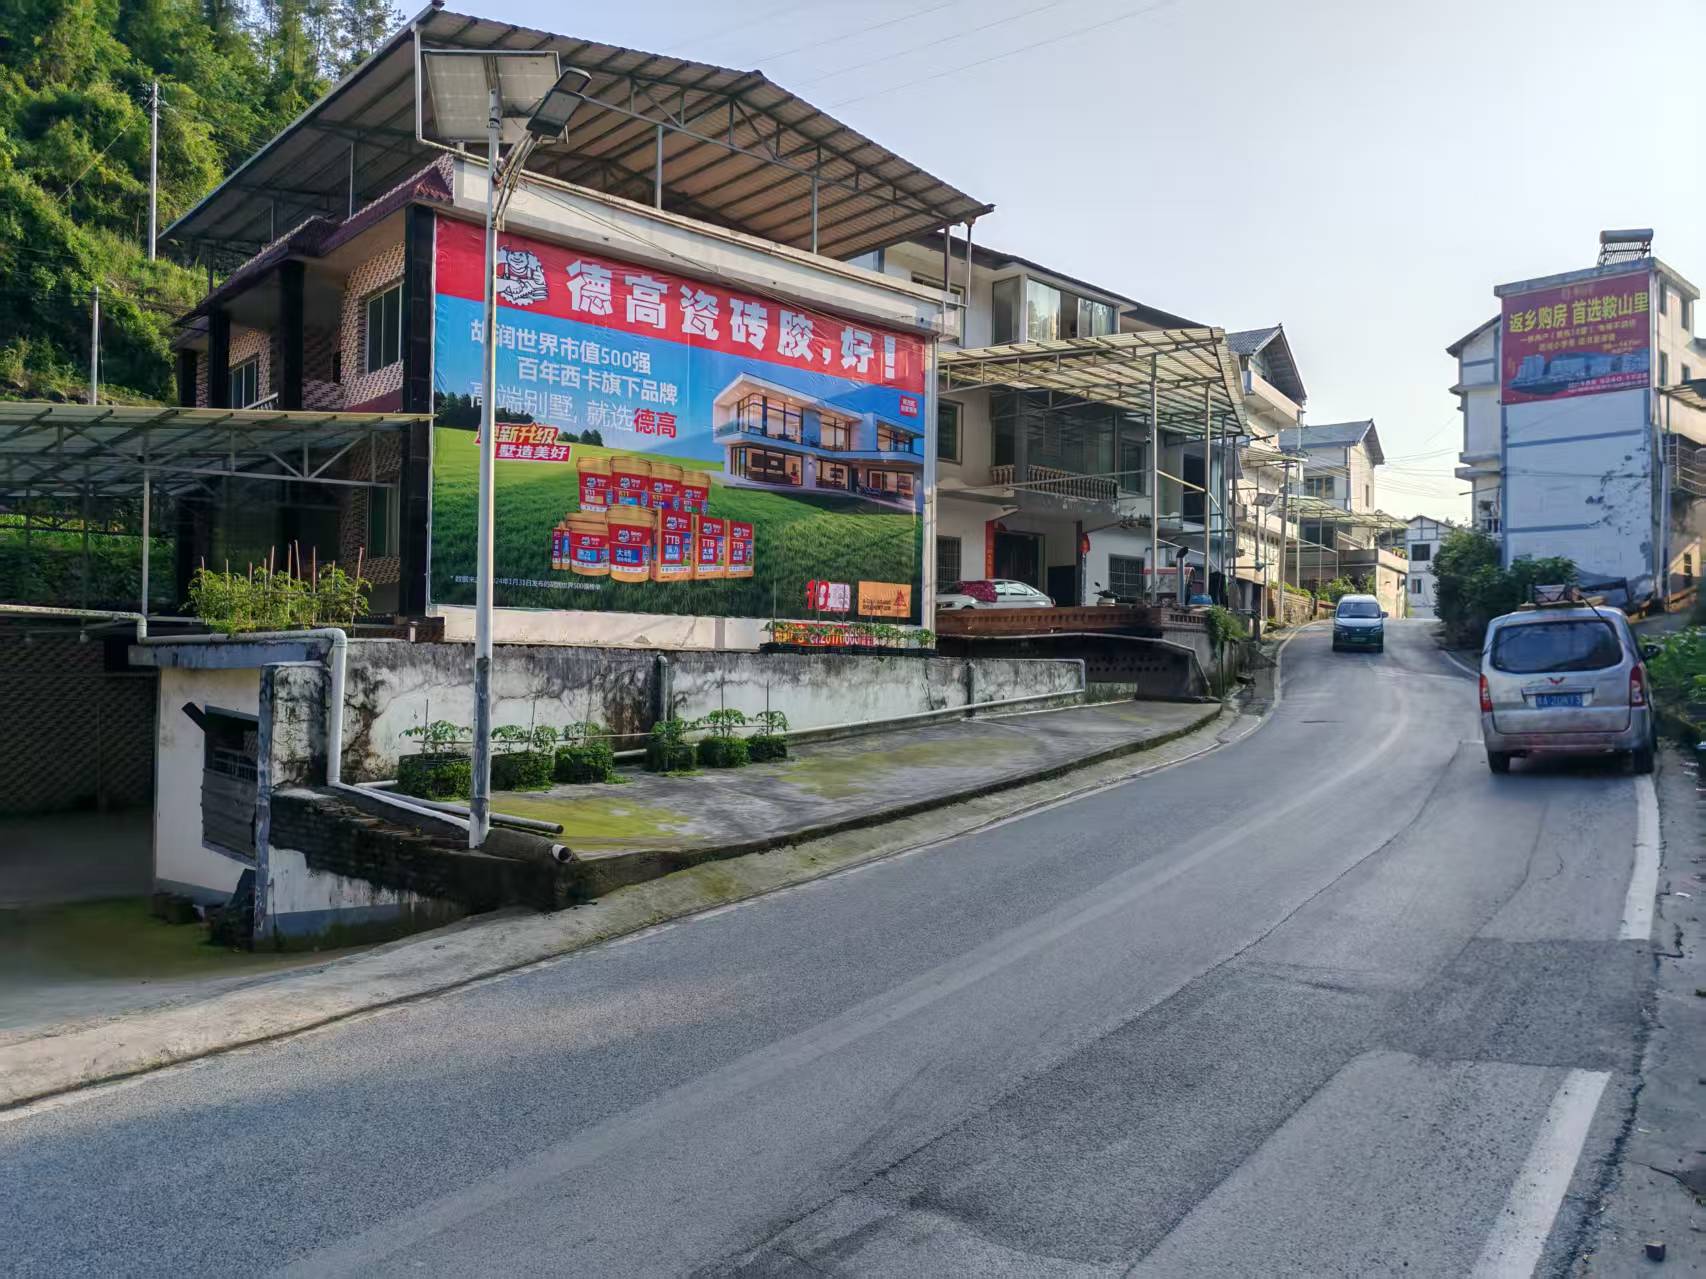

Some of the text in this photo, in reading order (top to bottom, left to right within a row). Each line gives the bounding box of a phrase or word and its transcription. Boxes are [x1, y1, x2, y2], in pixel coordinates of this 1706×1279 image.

[566, 259, 896, 379] 德高瓷砖胶，好！
[1509, 304, 1568, 333] 返乡购房
[471, 319, 651, 375] 胡润世界市值500强
[518, 356, 678, 406] 百年西卡旗下品牌
[480, 424, 555, 444] 新升级
[665, 535, 681, 545] TTB
[702, 539, 715, 547] TTB
[732, 541, 744, 549] TTB
